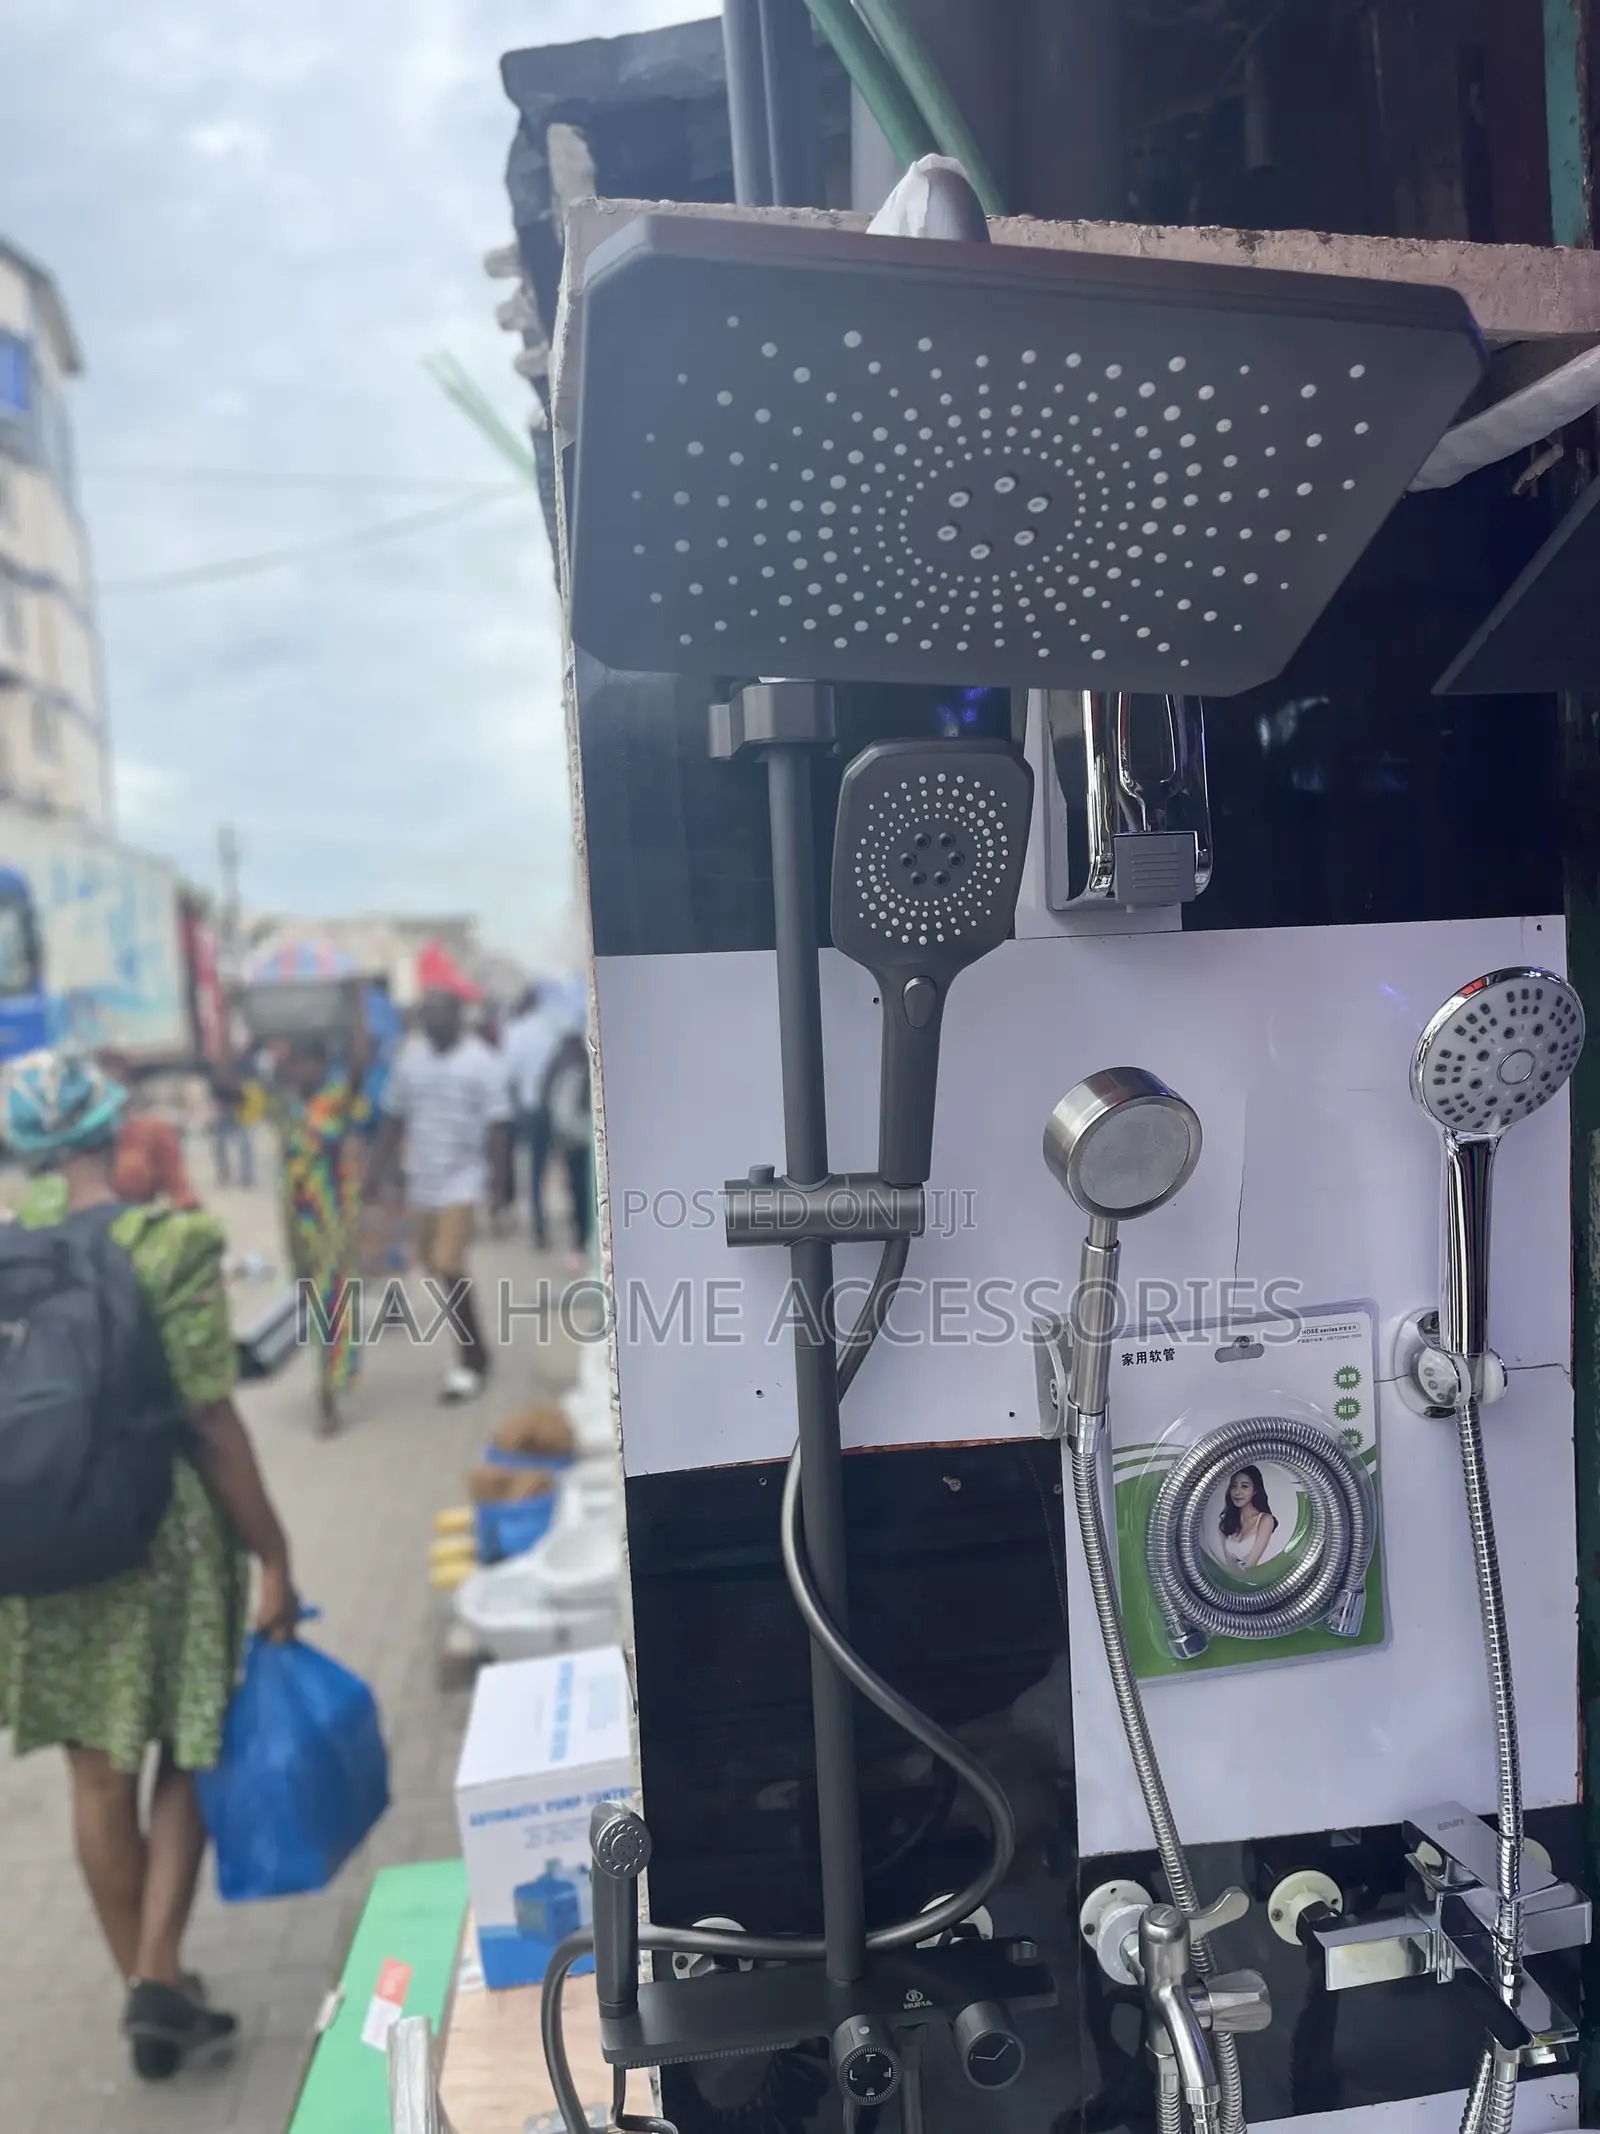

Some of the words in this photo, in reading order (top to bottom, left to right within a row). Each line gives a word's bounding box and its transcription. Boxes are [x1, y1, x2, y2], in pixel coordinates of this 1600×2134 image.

[1121, 1347, 1175, 1366] 家用软管
[1338, 1403, 1357, 1415] 耐压
